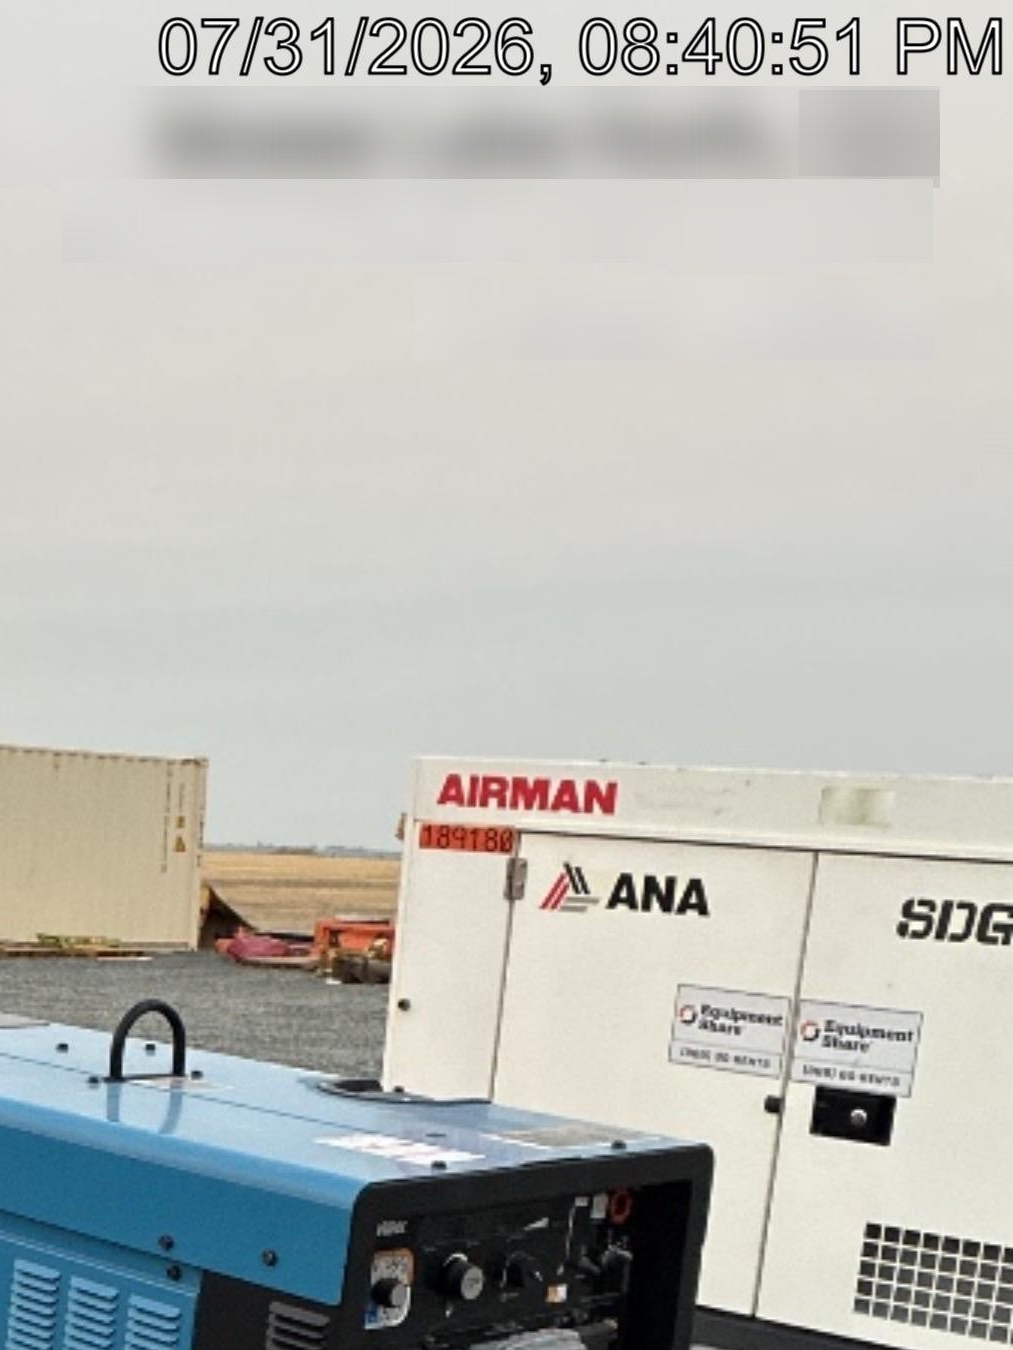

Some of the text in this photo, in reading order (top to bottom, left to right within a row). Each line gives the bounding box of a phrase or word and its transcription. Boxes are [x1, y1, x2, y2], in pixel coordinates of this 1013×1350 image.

[437, 773, 618, 816] AIRMAN
[422, 824, 514, 852] 189180
[606, 873, 709, 916] ANA
[700, 1004, 784, 1027] Equipment
[821, 1034, 868, 1052] Share
[824, 1020, 914, 1043] Equipment
